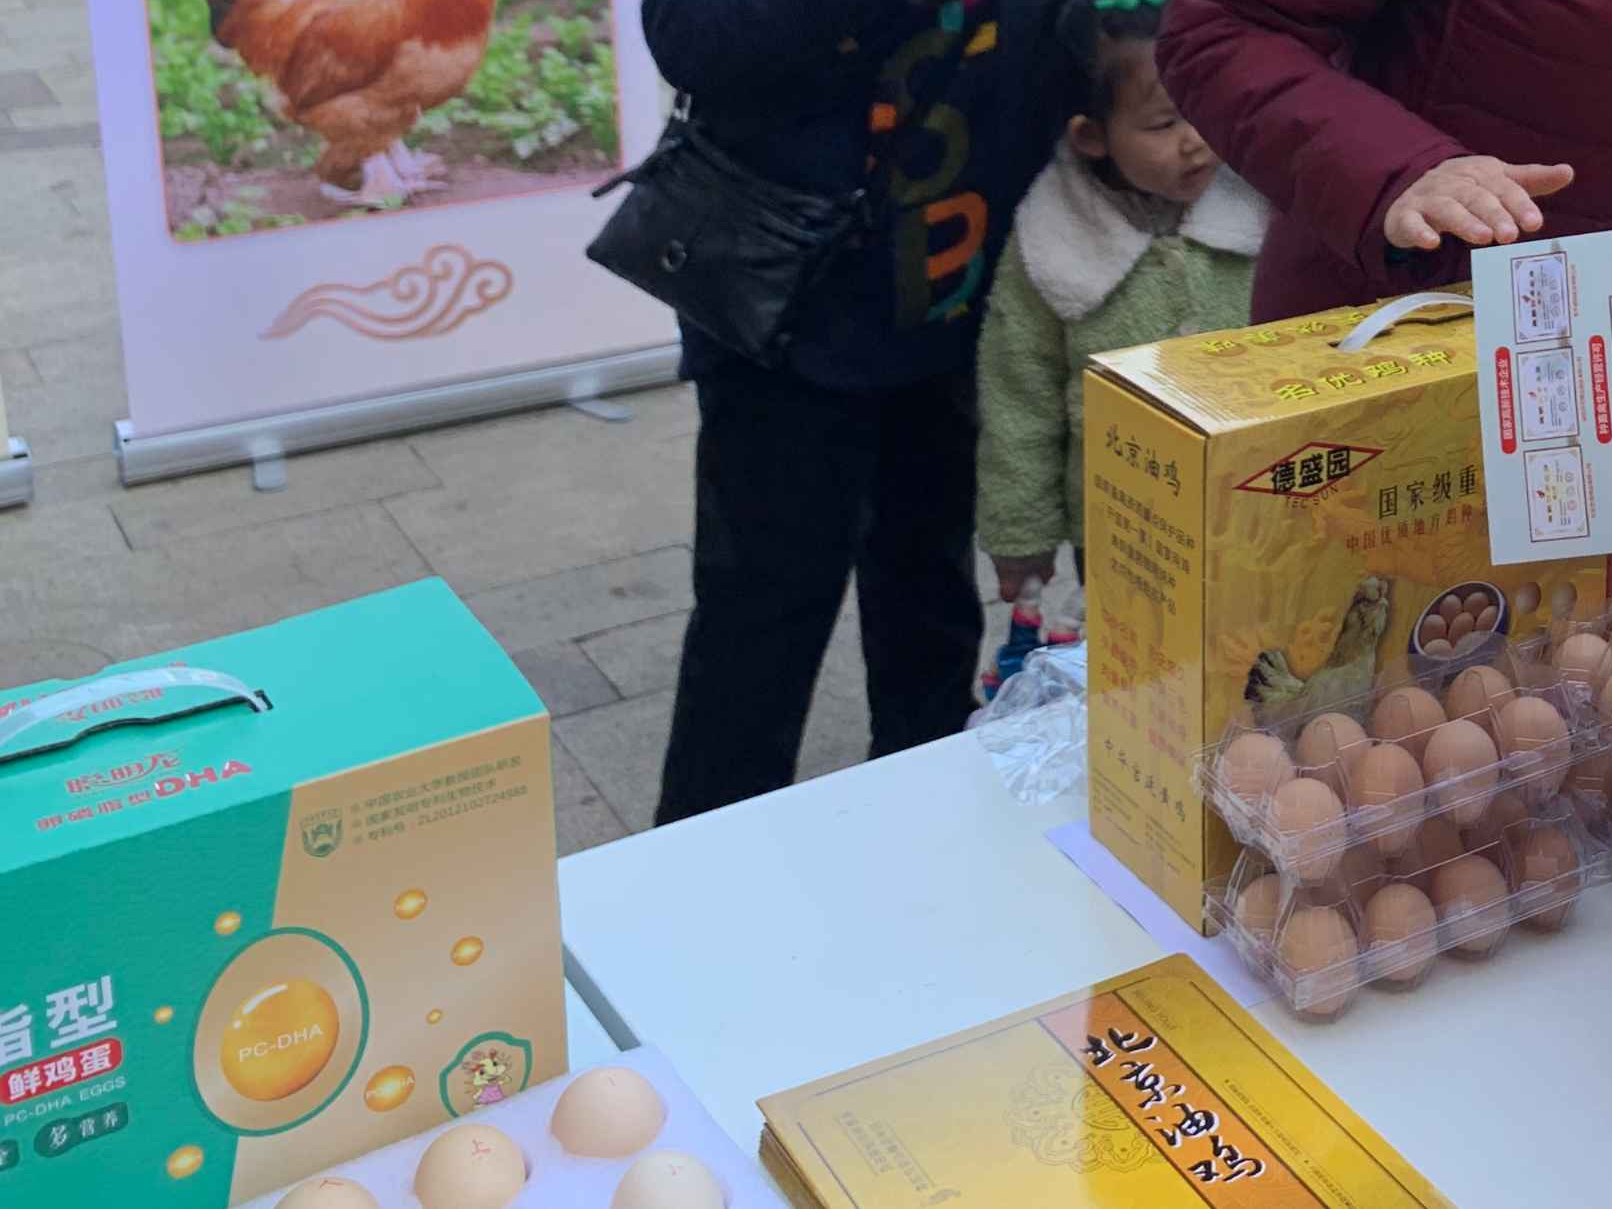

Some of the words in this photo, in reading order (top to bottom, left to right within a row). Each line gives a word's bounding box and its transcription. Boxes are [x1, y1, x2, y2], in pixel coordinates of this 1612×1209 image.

[1104, 422, 1182, 498] 北京油鸡
[1270, 445, 1351, 494] 德盛园
[238, 1023, 323, 1063] PC-DHA
[8, 1042, 113, 1101] 鲜鸡蛋
[4, 1094, 73, 1127] PC-DHA
[79, 1075, 127, 1102] EGGS
[1084, 1026, 1265, 1184] 北京油鸡
